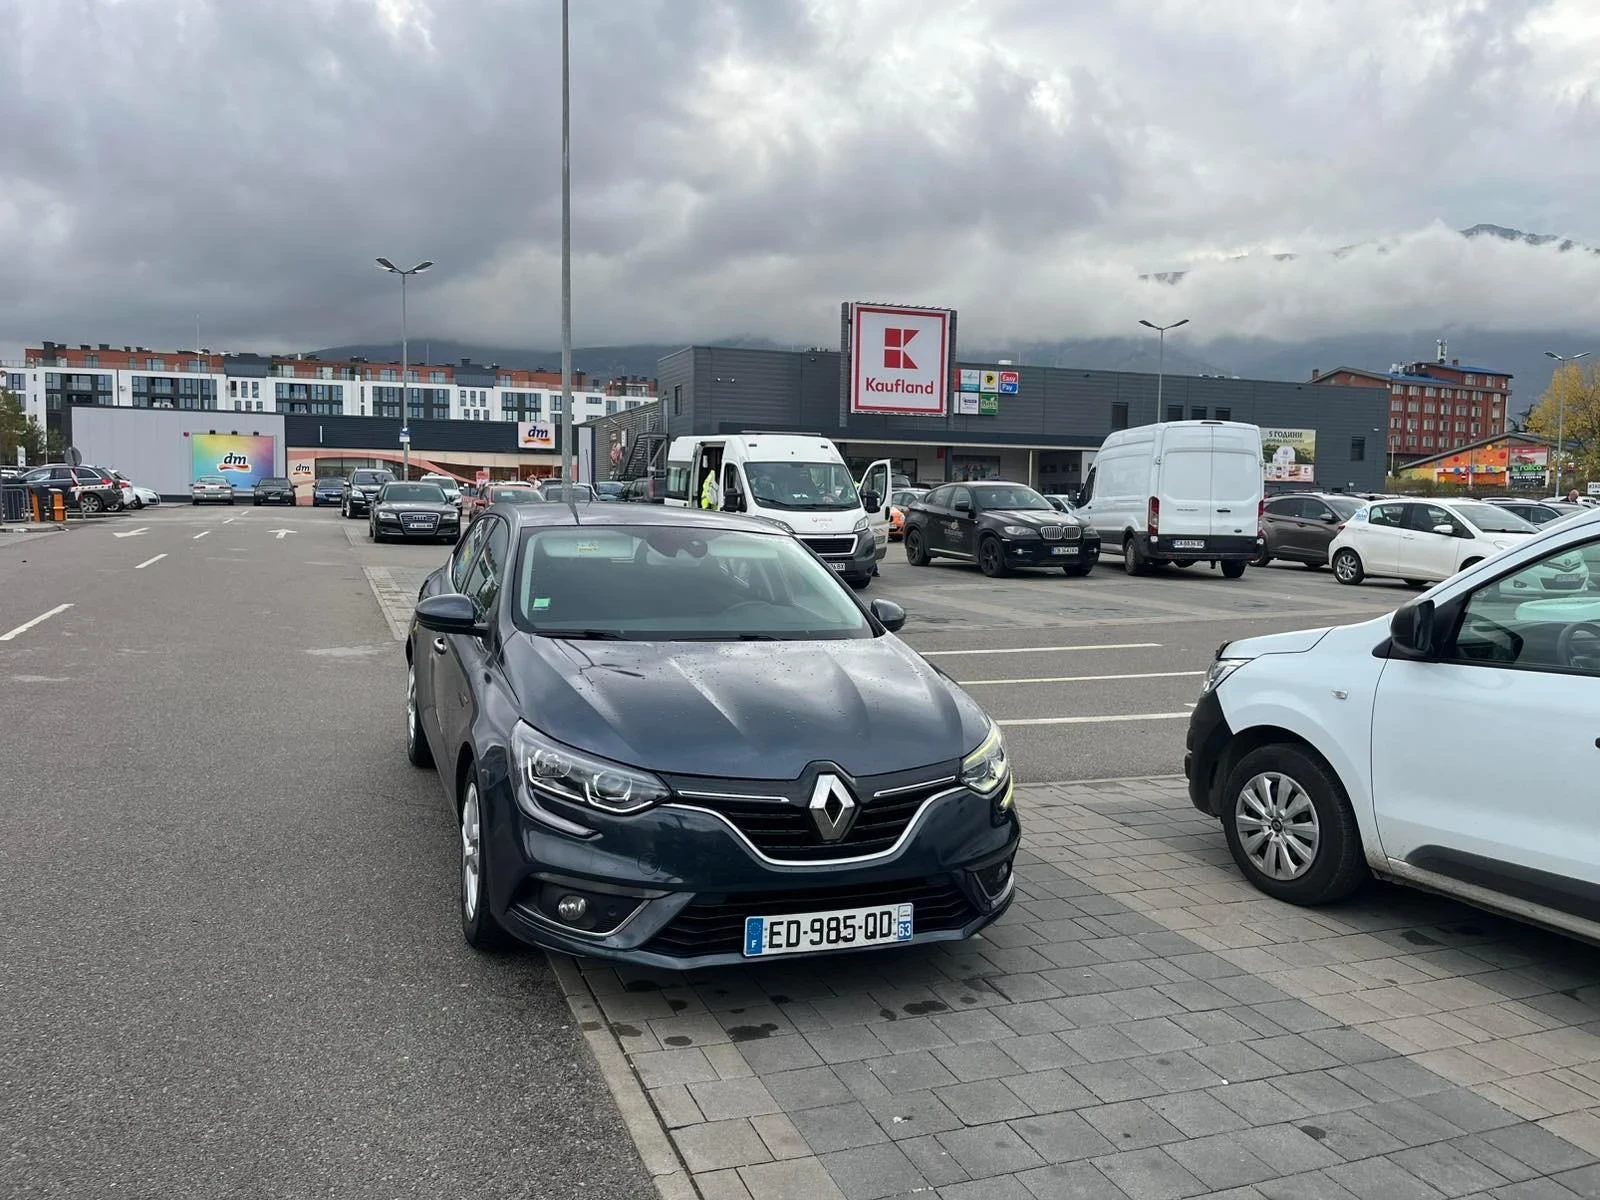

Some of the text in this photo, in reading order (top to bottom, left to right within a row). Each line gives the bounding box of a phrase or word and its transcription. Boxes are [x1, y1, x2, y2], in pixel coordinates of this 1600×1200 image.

[1002, 374, 1016, 382] Easy
[866, 377, 934, 395] Kaufland
[1002, 384, 1013, 392] Pay
[528, 426, 549, 438] dm
[1274, 431, 1303, 439] ГОДИНИ
[223, 452, 247, 465] dm
[295, 463, 310, 472] dm
[768, 910, 893, 949] ED-985-QD
[898, 922, 911, 937] 63
[751, 939, 757, 949] F
